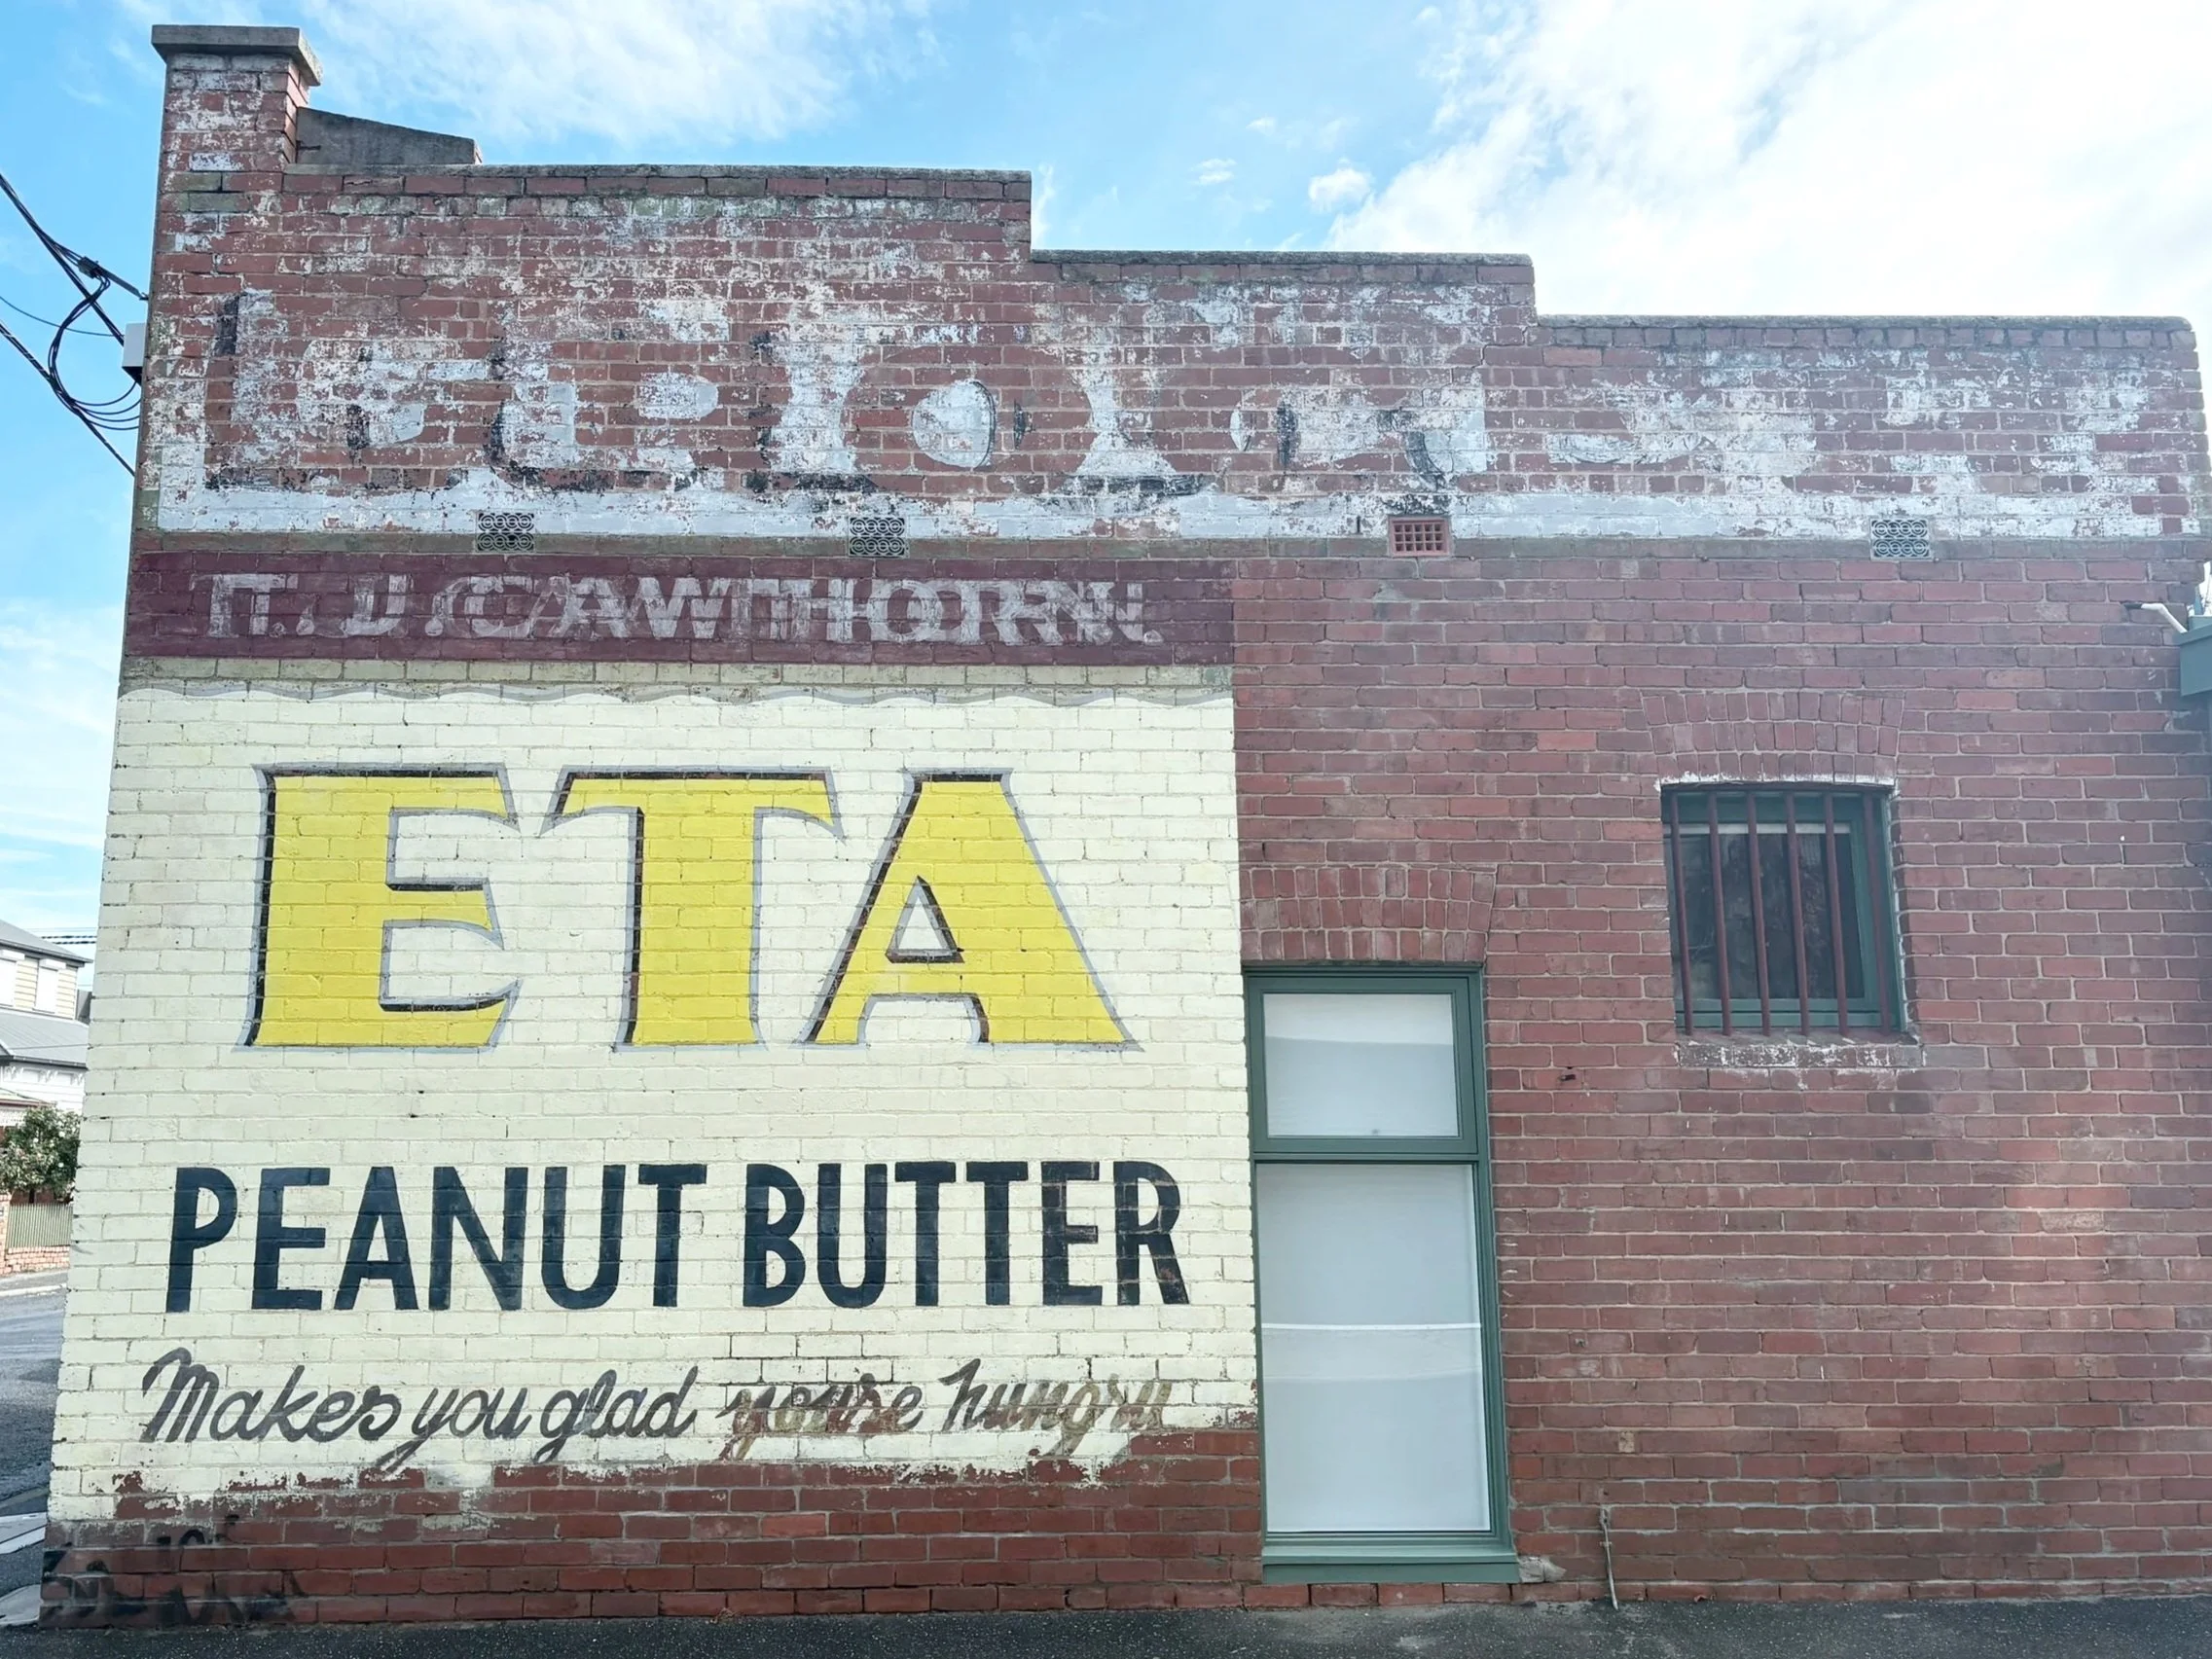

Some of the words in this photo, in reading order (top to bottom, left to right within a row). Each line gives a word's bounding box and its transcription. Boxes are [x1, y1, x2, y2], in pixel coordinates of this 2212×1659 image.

[232, 763, 1144, 1053] ETA
[164, 1163, 708, 1315] PEANUT
[742, 1161, 1190, 1308] BUTTER
[139, 1347, 401, 1443] Makes
[374, 1386, 533, 1470] you
[533, 1365, 699, 1462] glad
[937, 1357, 1174, 1463] hungry
